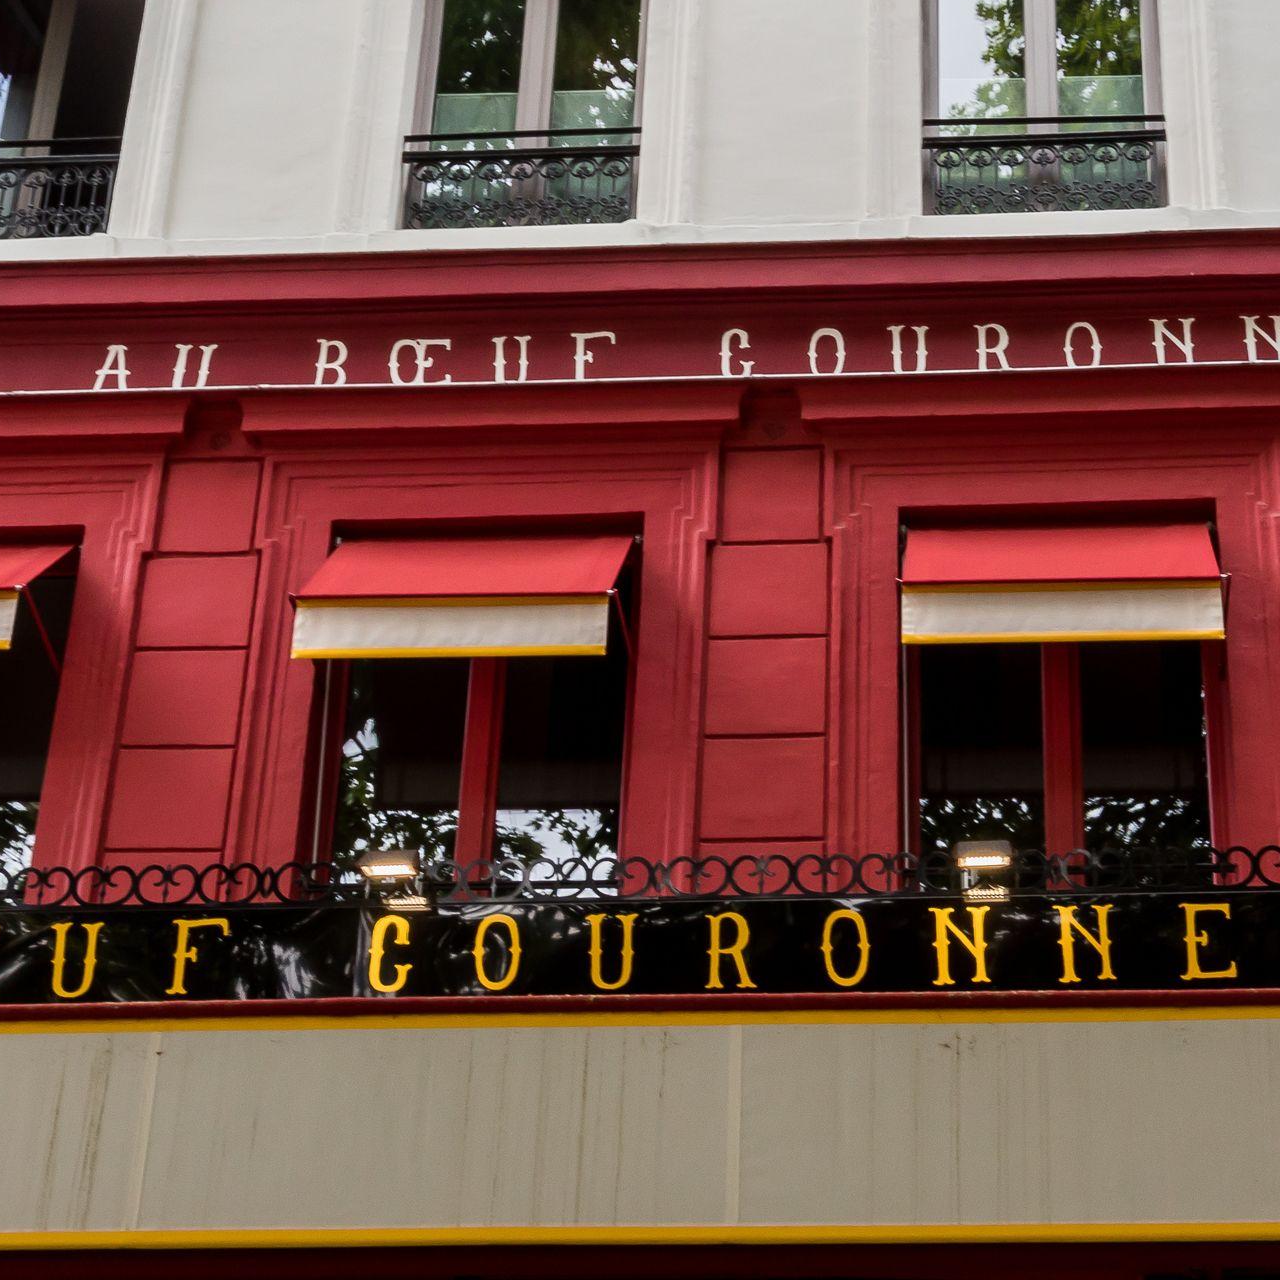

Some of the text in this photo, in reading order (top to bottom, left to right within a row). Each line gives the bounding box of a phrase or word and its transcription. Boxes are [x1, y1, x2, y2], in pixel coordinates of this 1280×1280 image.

[93, 343, 220, 391] AU
[314, 330, 617, 387] BŒUF
[368, 904, 1238, 993] COURONNE
